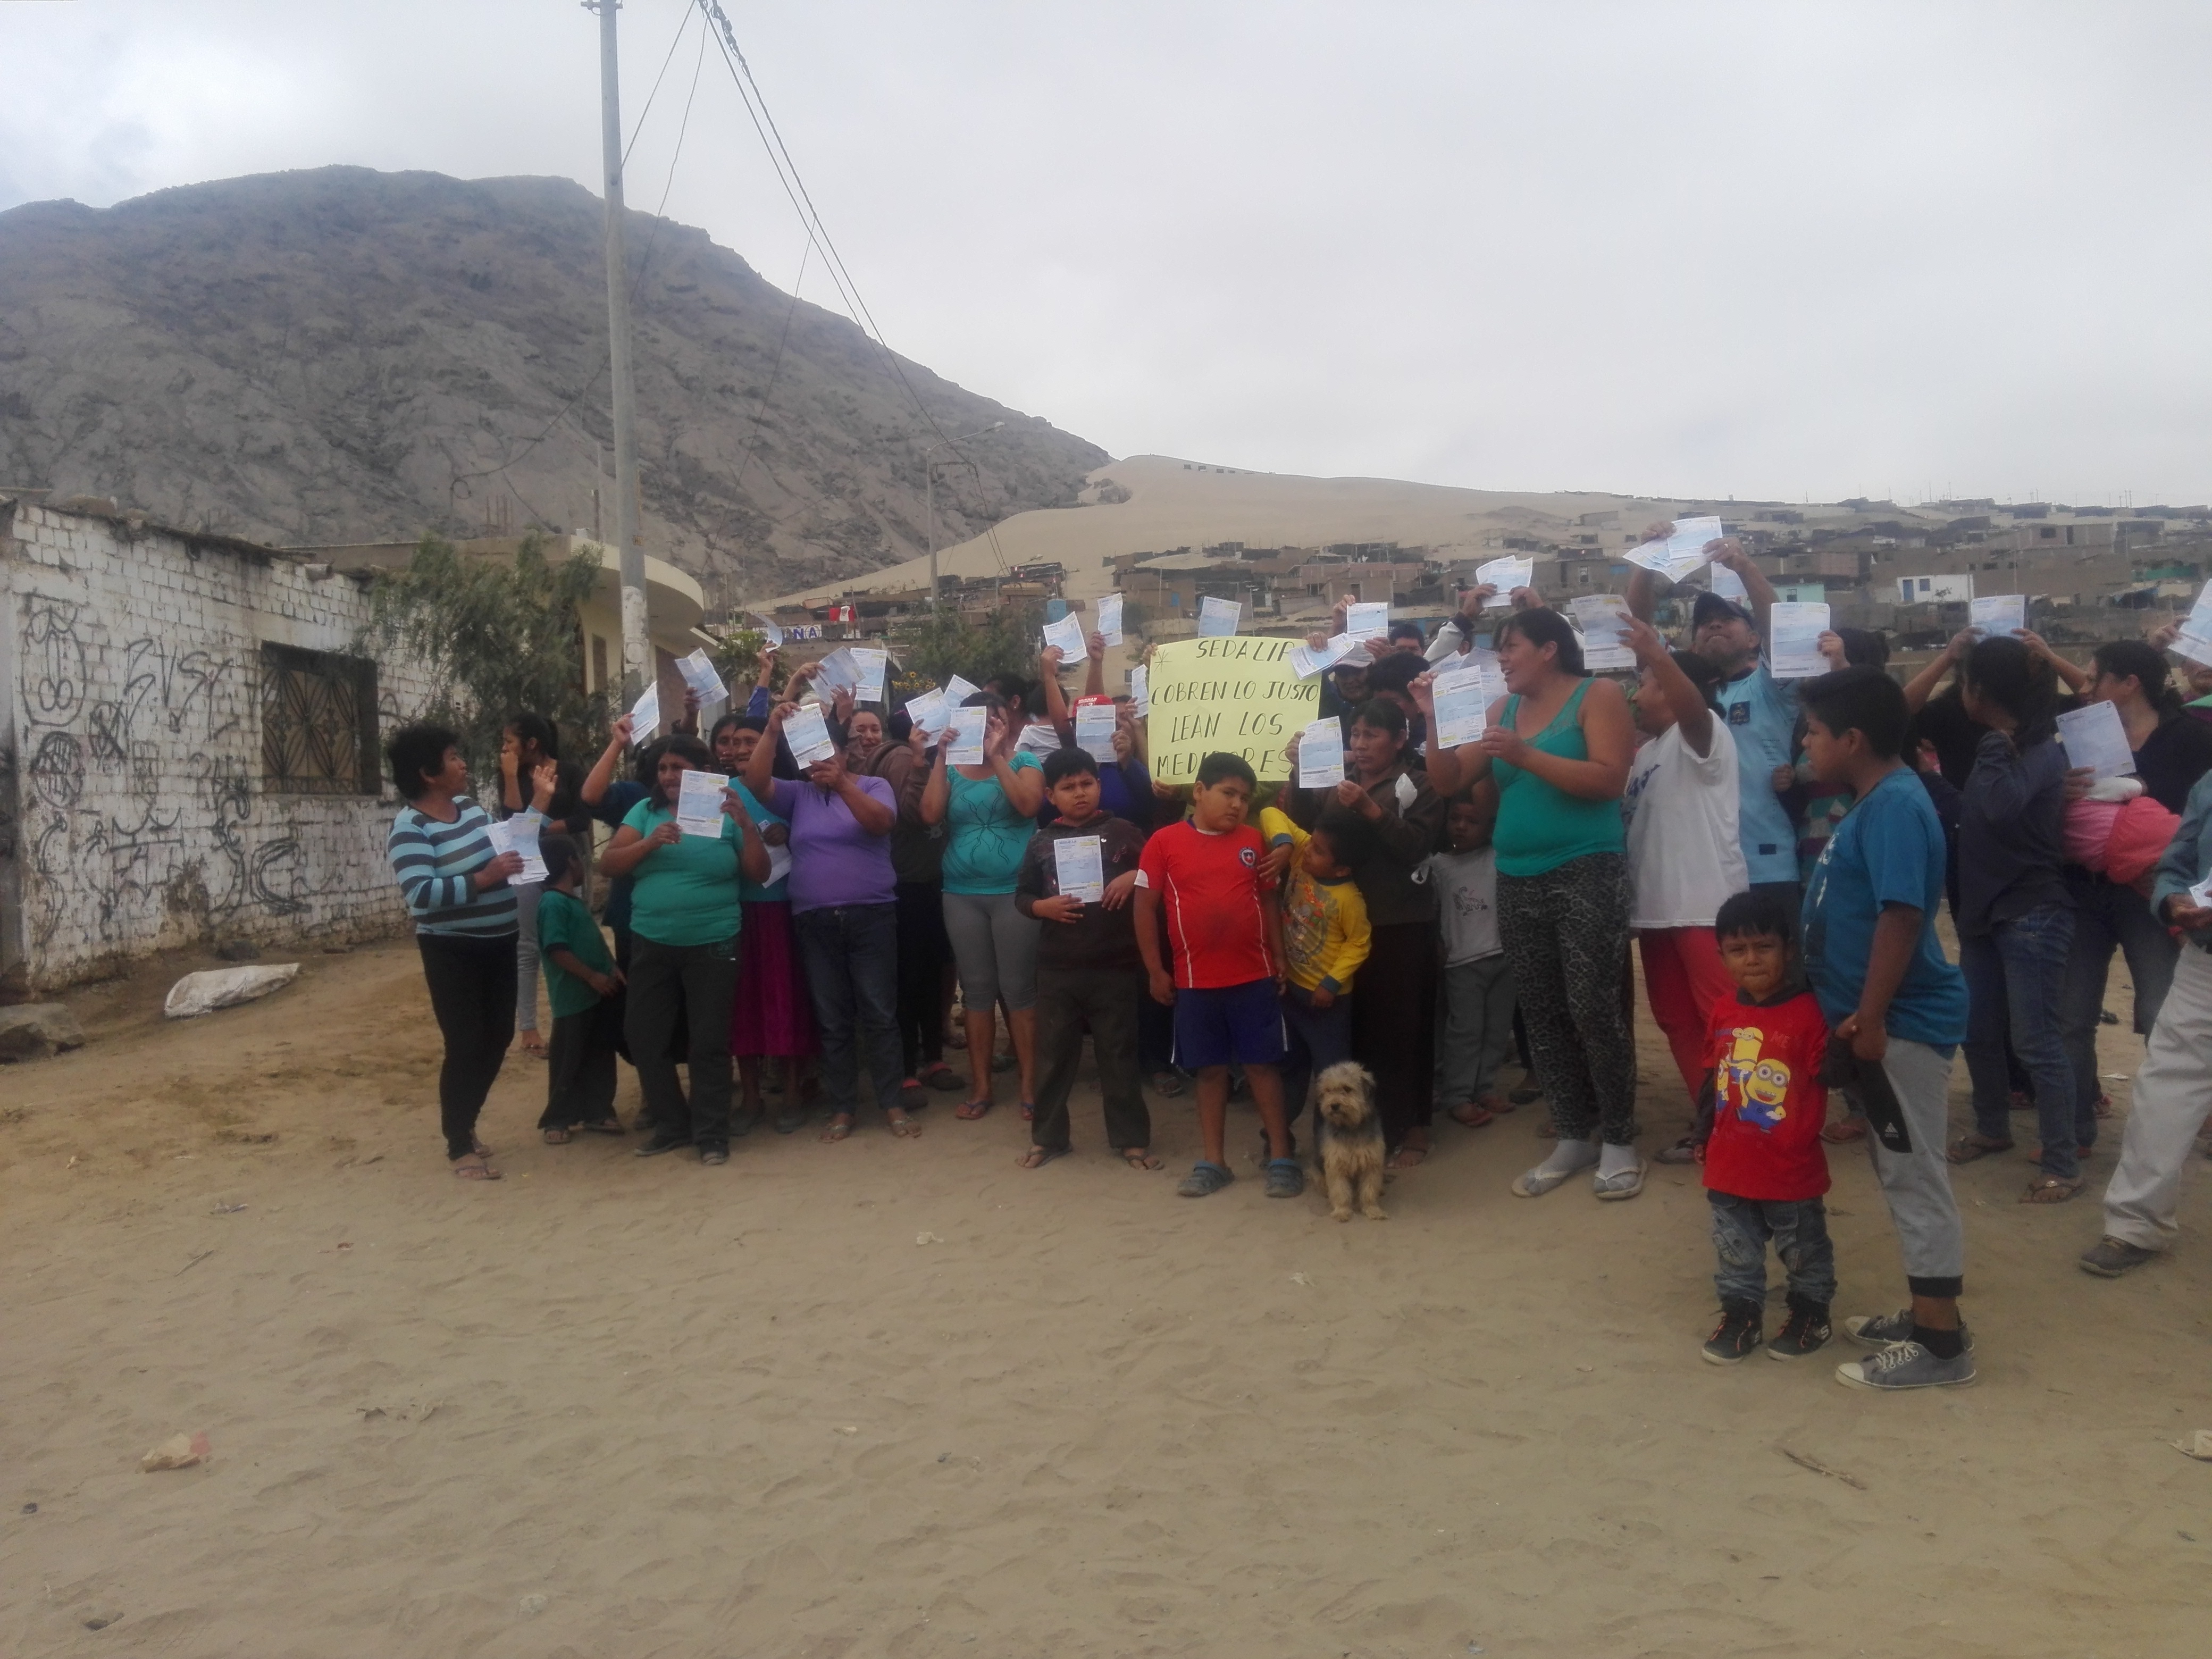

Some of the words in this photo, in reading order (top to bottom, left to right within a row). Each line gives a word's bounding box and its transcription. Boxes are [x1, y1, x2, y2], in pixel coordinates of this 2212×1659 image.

[1151, 681, 1228, 706] COBREN
[1233, 680, 1256, 700] LO
[1262, 681, 1319, 702] JUSTO
[1171, 712, 1221, 743] LEAN
[1238, 711, 1283, 735] LOS
